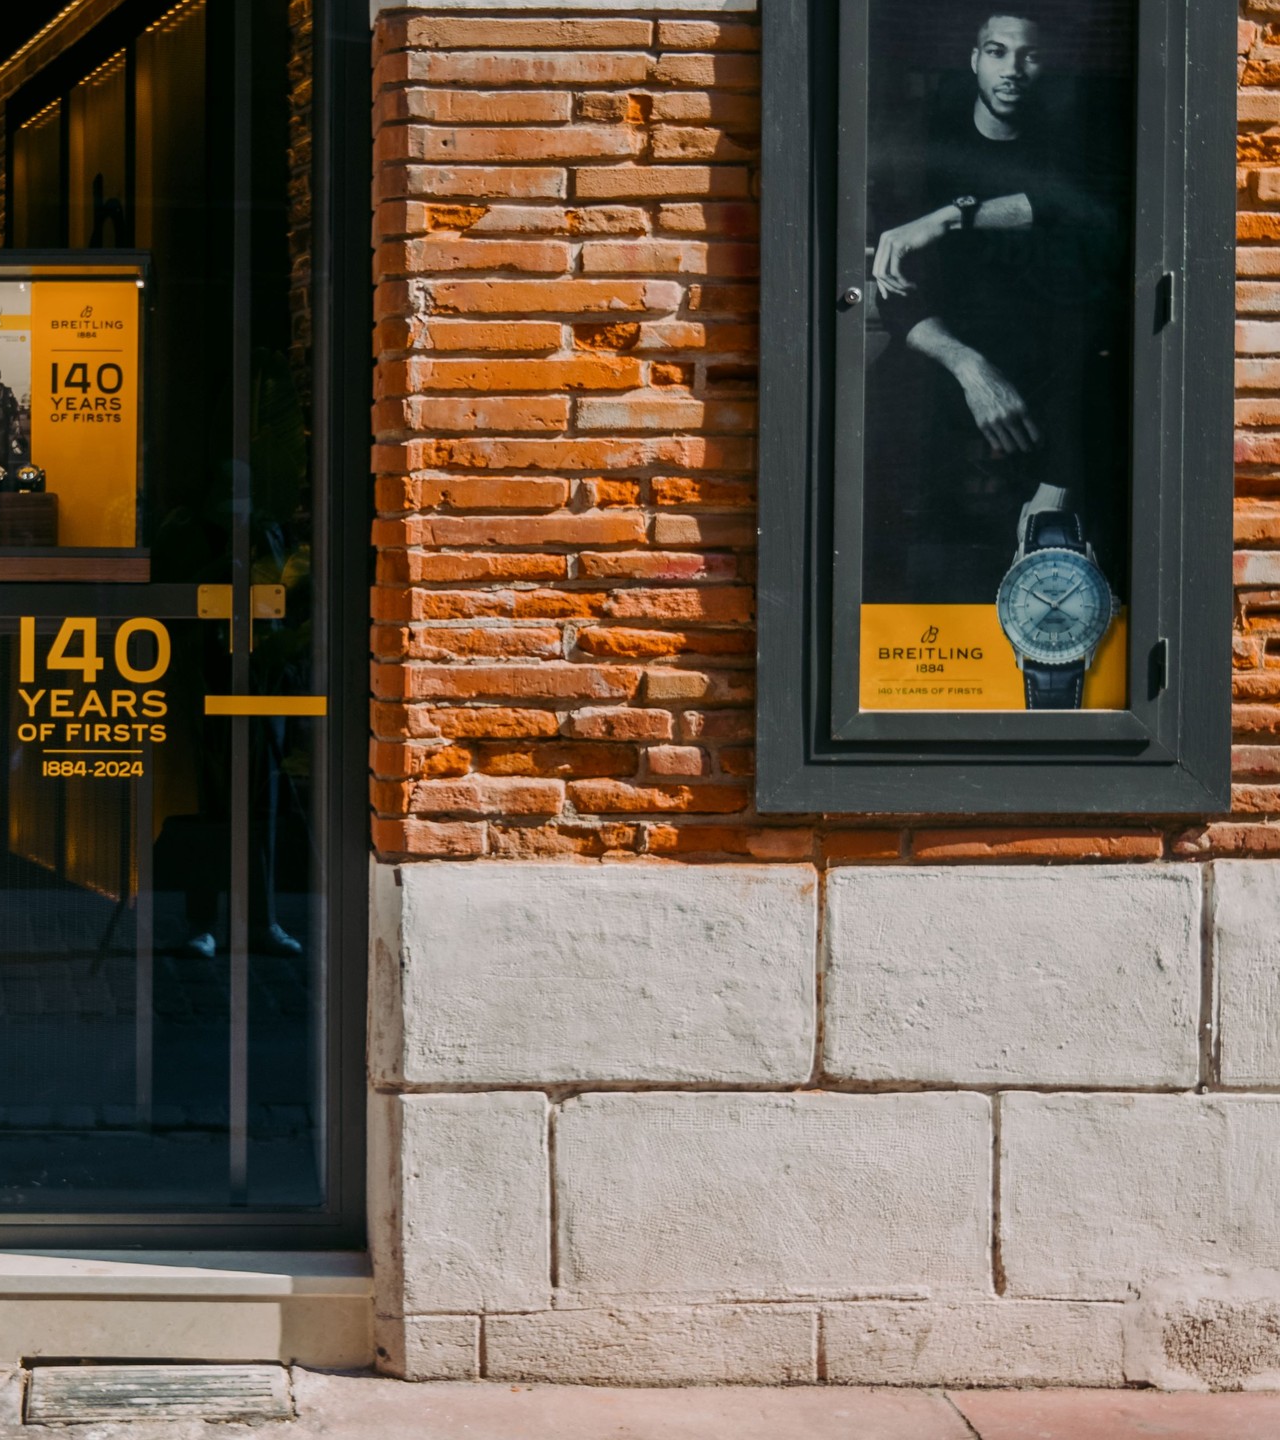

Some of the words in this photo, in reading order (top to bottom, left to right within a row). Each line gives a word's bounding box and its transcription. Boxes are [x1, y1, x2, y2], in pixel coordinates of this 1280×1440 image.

[51, 320, 124, 330] BREITLING
[76, 331, 97, 339] 1884
[51, 362, 123, 394] 140
[51, 397, 122, 410] YEARS
[51, 413, 69, 423] OF
[73, 413, 122, 423] FIRSTS
[19, 616, 171, 683] 140
[878, 647, 983, 660] BREITLING
[916, 664, 944, 673] 1884
[878, 687, 892, 695] 140
[894, 687, 928, 695] YEARS
[931, 687, 945, 695] OF
[948, 687, 983, 695] FIRSTS
[18, 689, 168, 718] YEARS
[18, 723, 54, 742] OF
[66, 723, 167, 742] FIRSTS
[42, 760, 144, 777] 1884-2024
